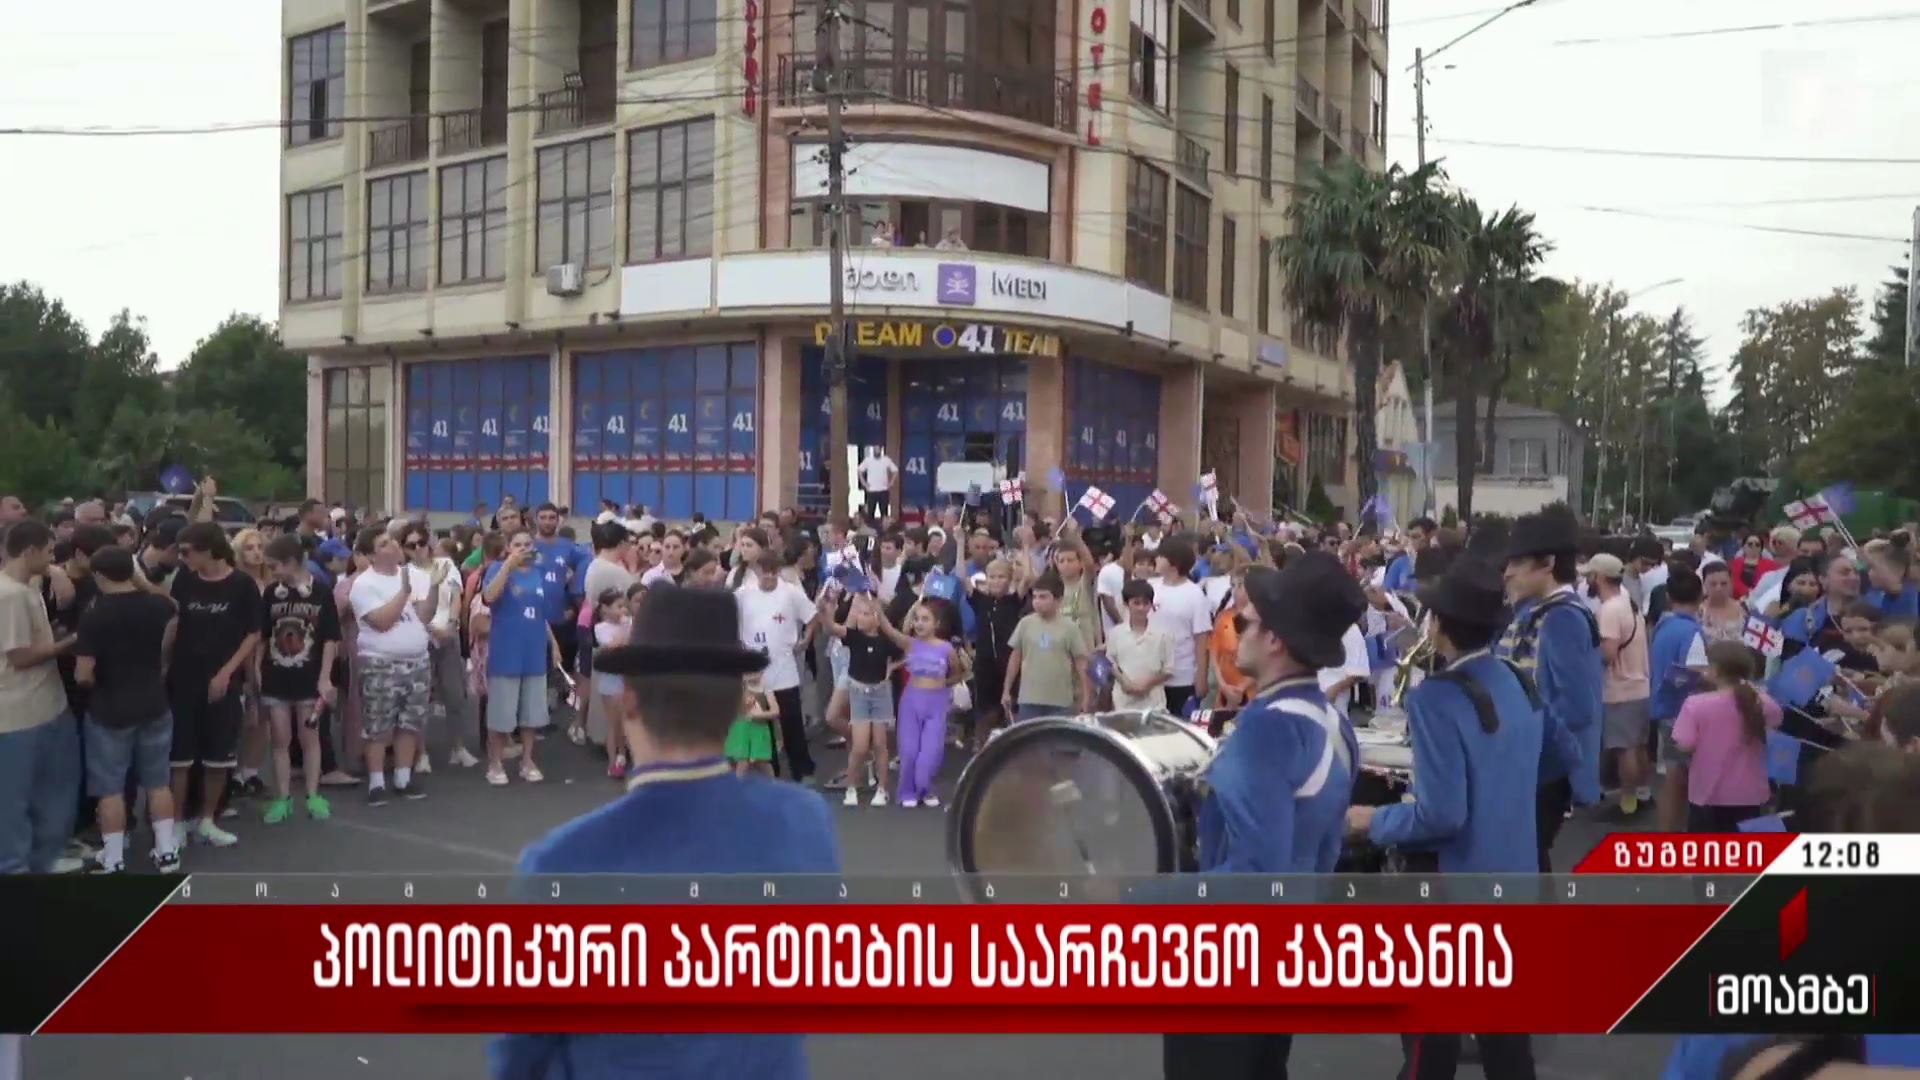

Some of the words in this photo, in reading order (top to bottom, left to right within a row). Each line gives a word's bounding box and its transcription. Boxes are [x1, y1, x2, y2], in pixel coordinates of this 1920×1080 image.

[992, 270, 1047, 300] MEDI
[814, 320, 922, 347] DEAM
[957, 323, 995, 354] 41
[1002, 327, 1061, 357] TEAM
[937, 403, 959, 421] 41
[1002, 402, 1025, 420] 41
[432, 420, 449, 437] 41
[481, 418, 498, 437] 41
[532, 415, 550, 433] 41
[606, 415, 626, 434] 41
[667, 413, 688, 433] 41
[732, 411, 754, 432] 41
[906, 456, 927, 475] 41
[544, 571, 557, 583] 41
[523, 606, 536, 619] 41
